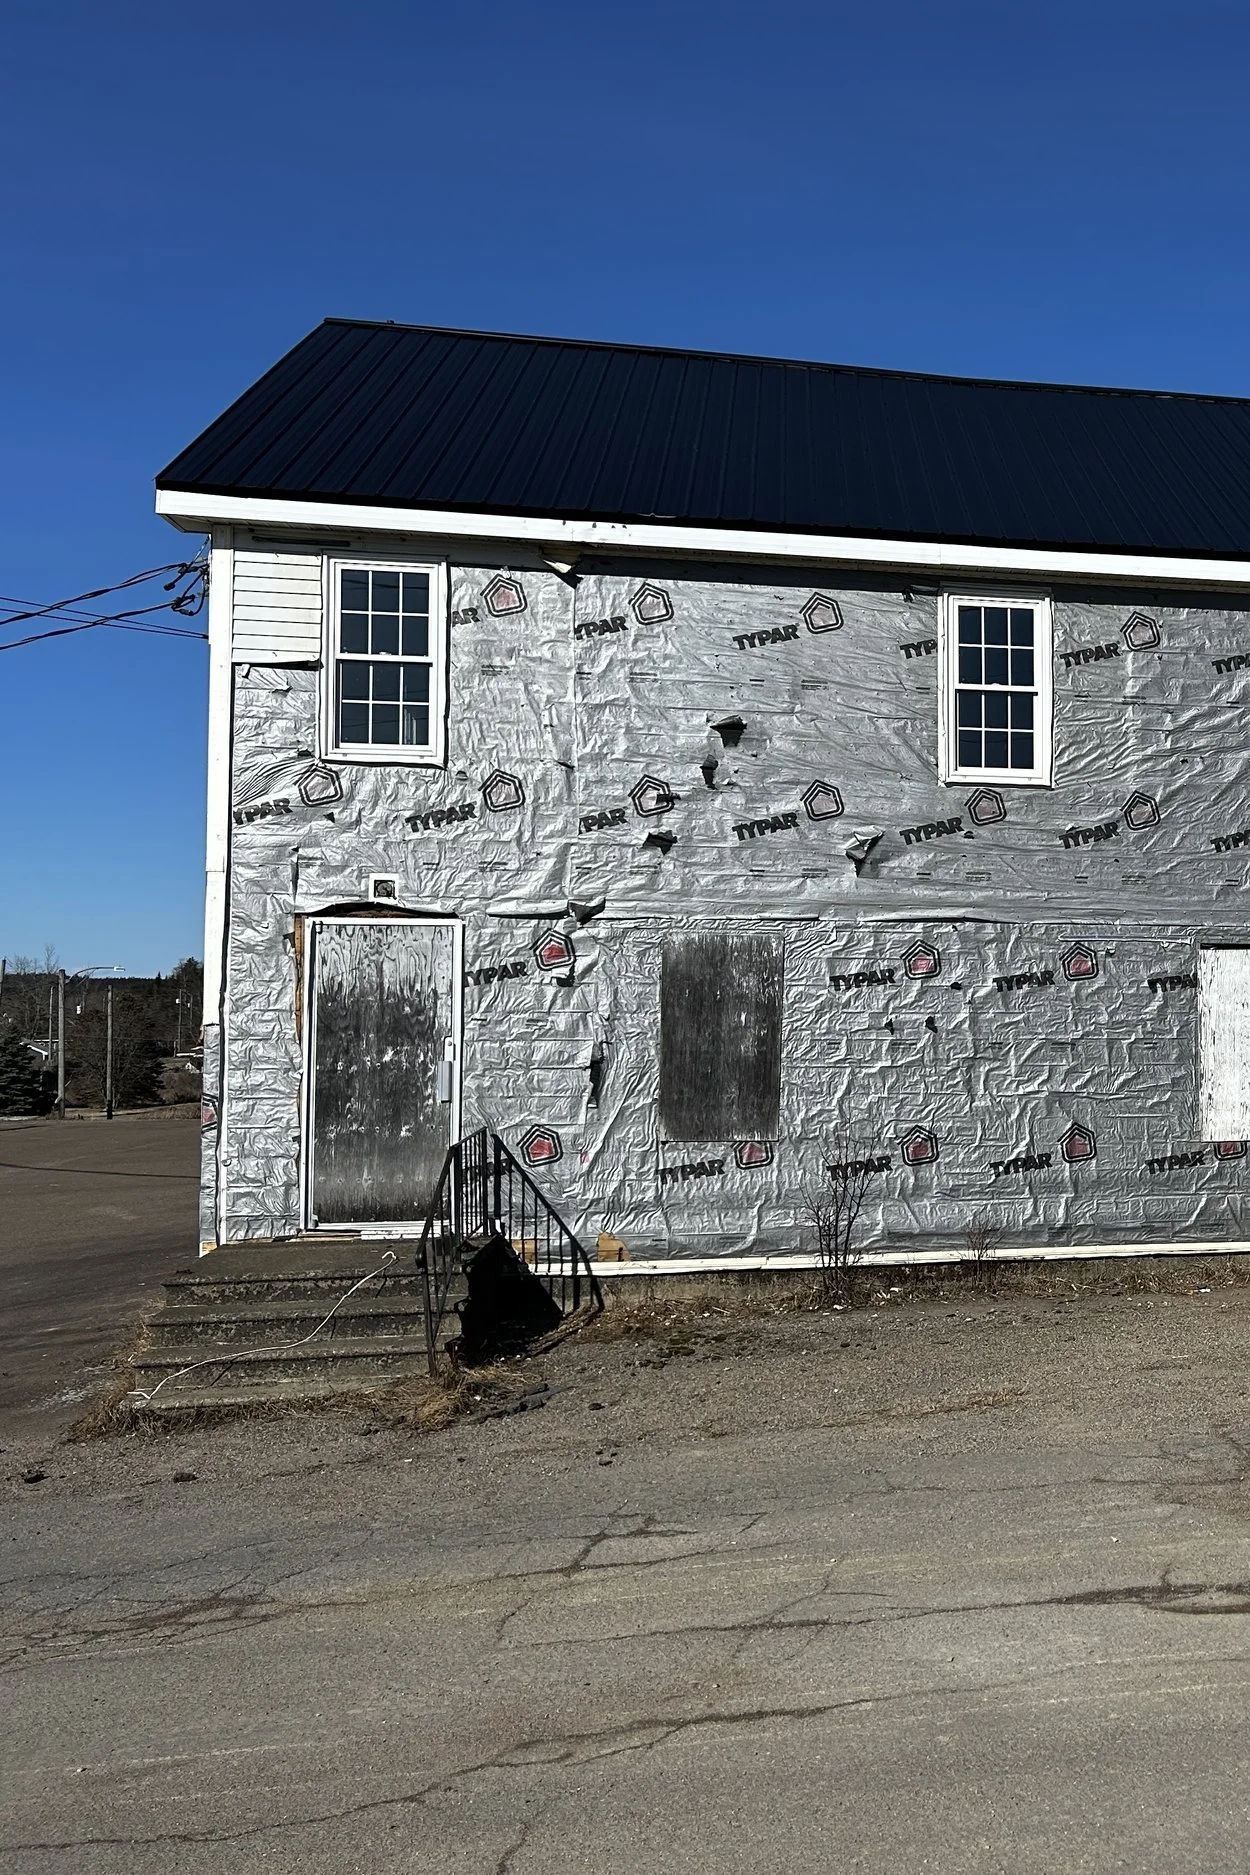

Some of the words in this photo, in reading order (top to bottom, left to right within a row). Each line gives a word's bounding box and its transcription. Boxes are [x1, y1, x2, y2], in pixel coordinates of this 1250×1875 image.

[574, 616, 628, 640] YPAR
[732, 625, 800, 650] TYPAR
[900, 639, 938, 659] TYP
[1060, 643, 1120, 667] TYPAR
[233, 798, 293, 825] YPAR
[405, 802, 477, 832] TYPAR
[579, 808, 629, 836] PAR
[732, 812, 799, 841] TYPAR
[900, 818, 964, 845] TYPAR
[1059, 822, 1119, 849] TYPAR
[464, 962, 528, 987] YPAR
[829, 968, 895, 991] TYPAR
[992, 971, 1055, 992] TYPAR
[1147, 974, 1197, 993] TYPA
[658, 1159, 725, 1184] TYPAR
[826, 1155, 892, 1181] TYPAR
[990, 1152, 1052, 1178] TYPAR
[1146, 1151, 1204, 1174] TYPAR
